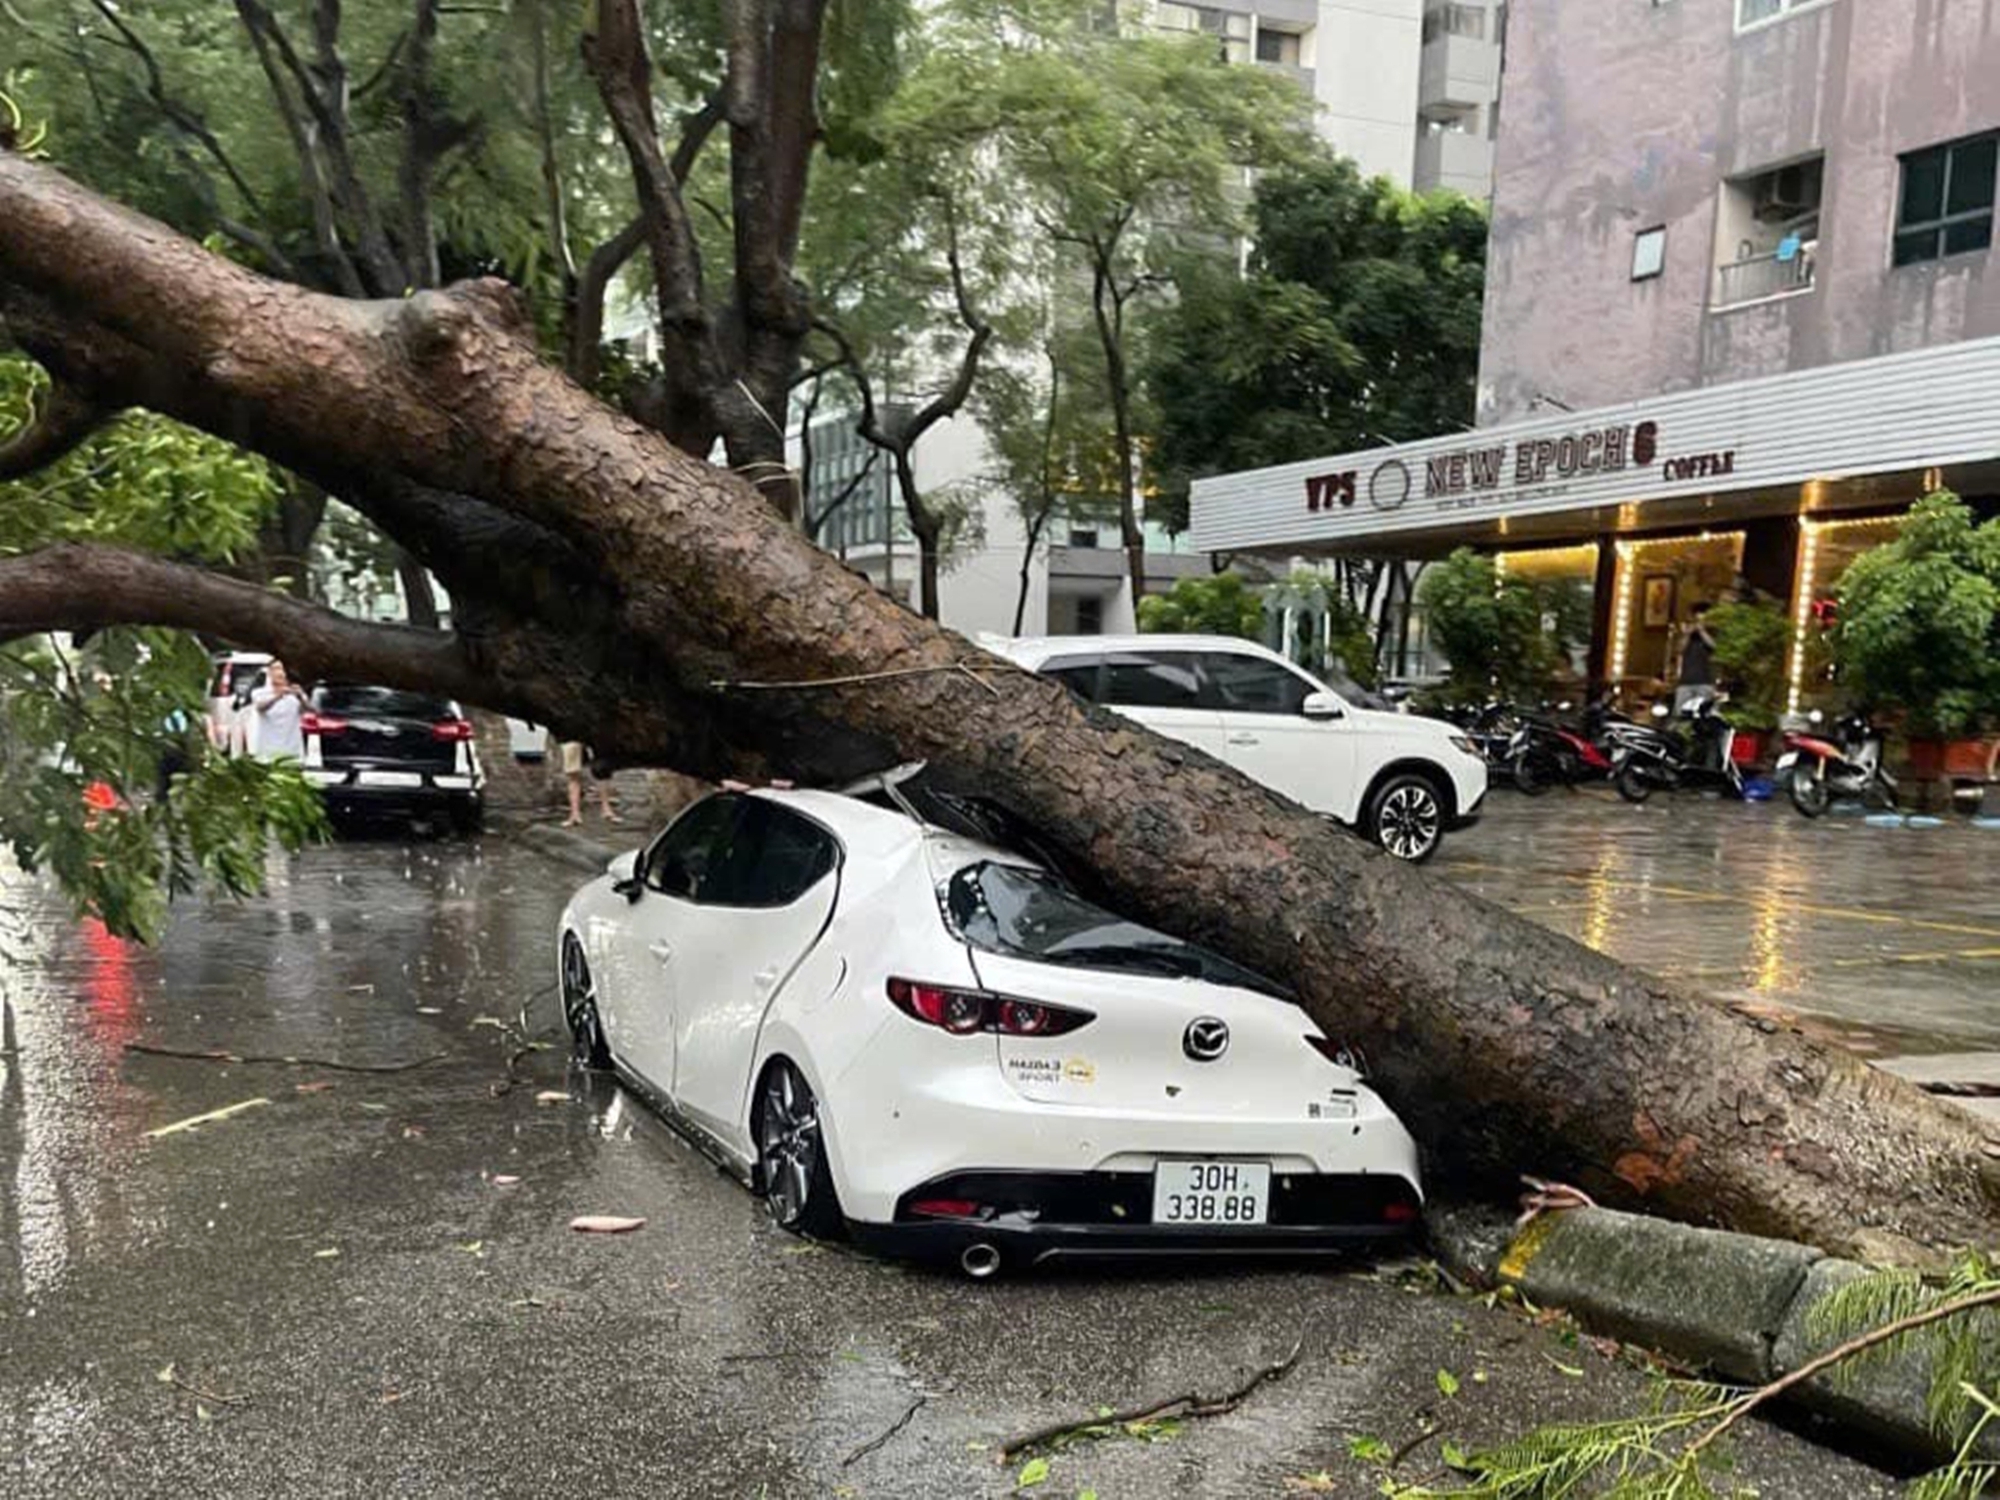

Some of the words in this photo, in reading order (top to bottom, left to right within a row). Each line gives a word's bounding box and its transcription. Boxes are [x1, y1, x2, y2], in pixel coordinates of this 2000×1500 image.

[1425, 447, 1506, 498] NEW
[1514, 424, 1631, 485] EPOCH
[1663, 451, 1736, 482] COFFEE
[1305, 470, 1358, 512] VPS
[1189, 1165, 1238, 1192] 30H
[1167, 1194, 1256, 1221] 338.88
